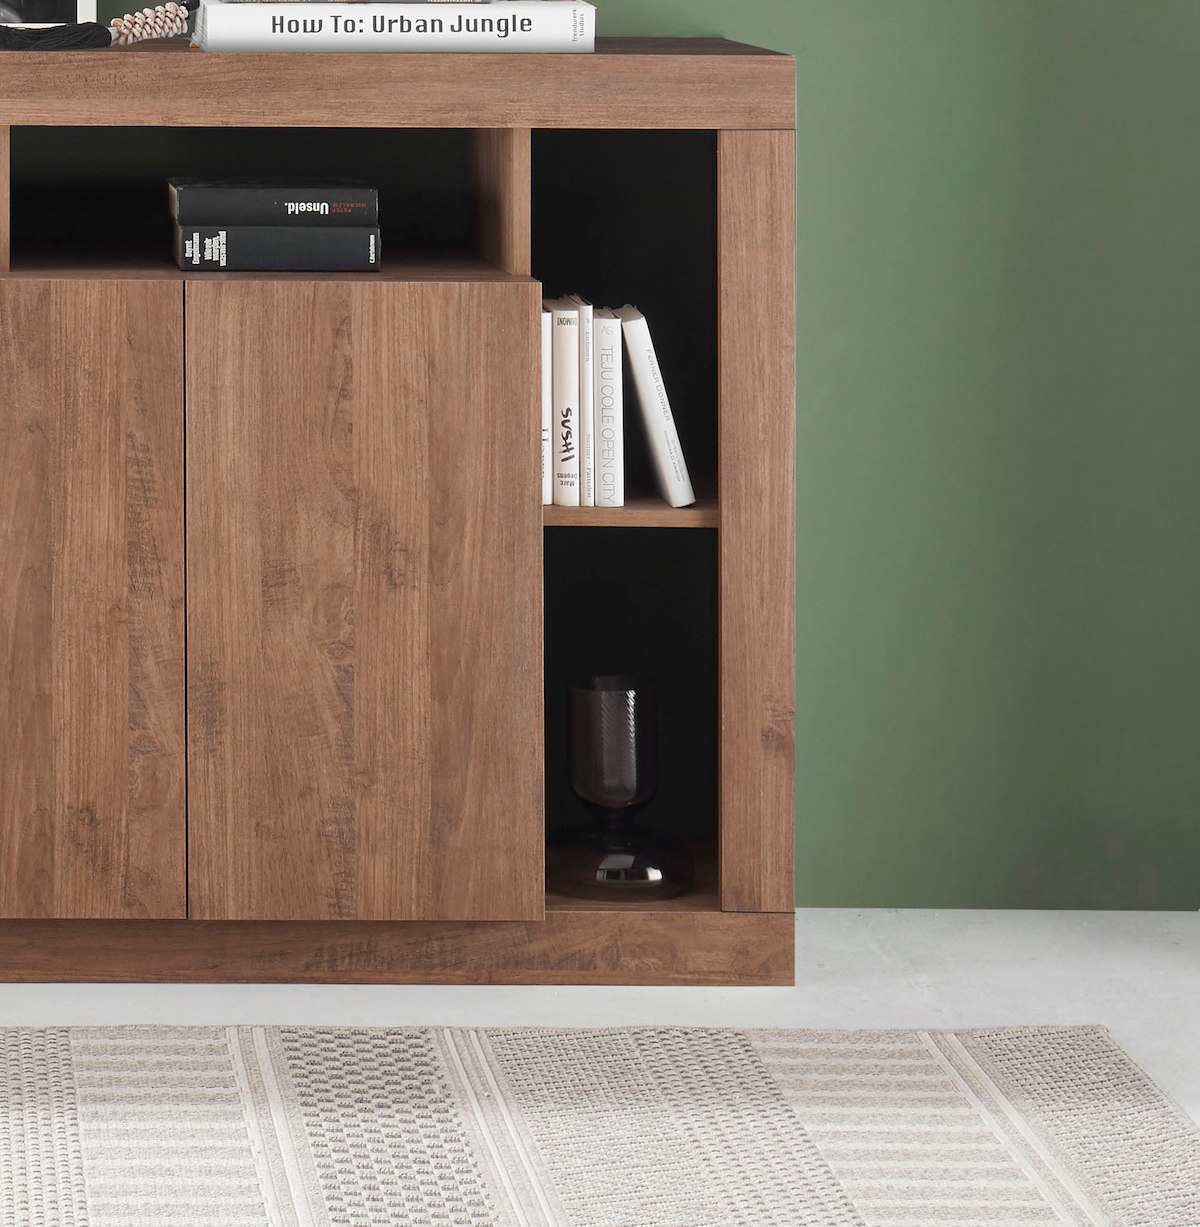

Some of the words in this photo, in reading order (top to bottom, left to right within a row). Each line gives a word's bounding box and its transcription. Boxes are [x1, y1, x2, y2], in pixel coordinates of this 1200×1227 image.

[271, 15, 323, 35] How
[330, 15, 364, 34] To:
[372, 14, 444, 34] Urban
[450, 14, 532, 38] Jungle
[284, 202, 329, 214] Unseld.
[556, 318, 578, 326] DUMONT
[600, 345, 614, 380] TEJU
[646, 348, 660, 383] FERNER
[656, 384, 670, 422] DONNER
[600, 385, 615, 424] COLE
[560, 407, 575, 462] SUSHI
[602, 428, 615, 468] OPEN
[602, 472, 616, 503] CITY
